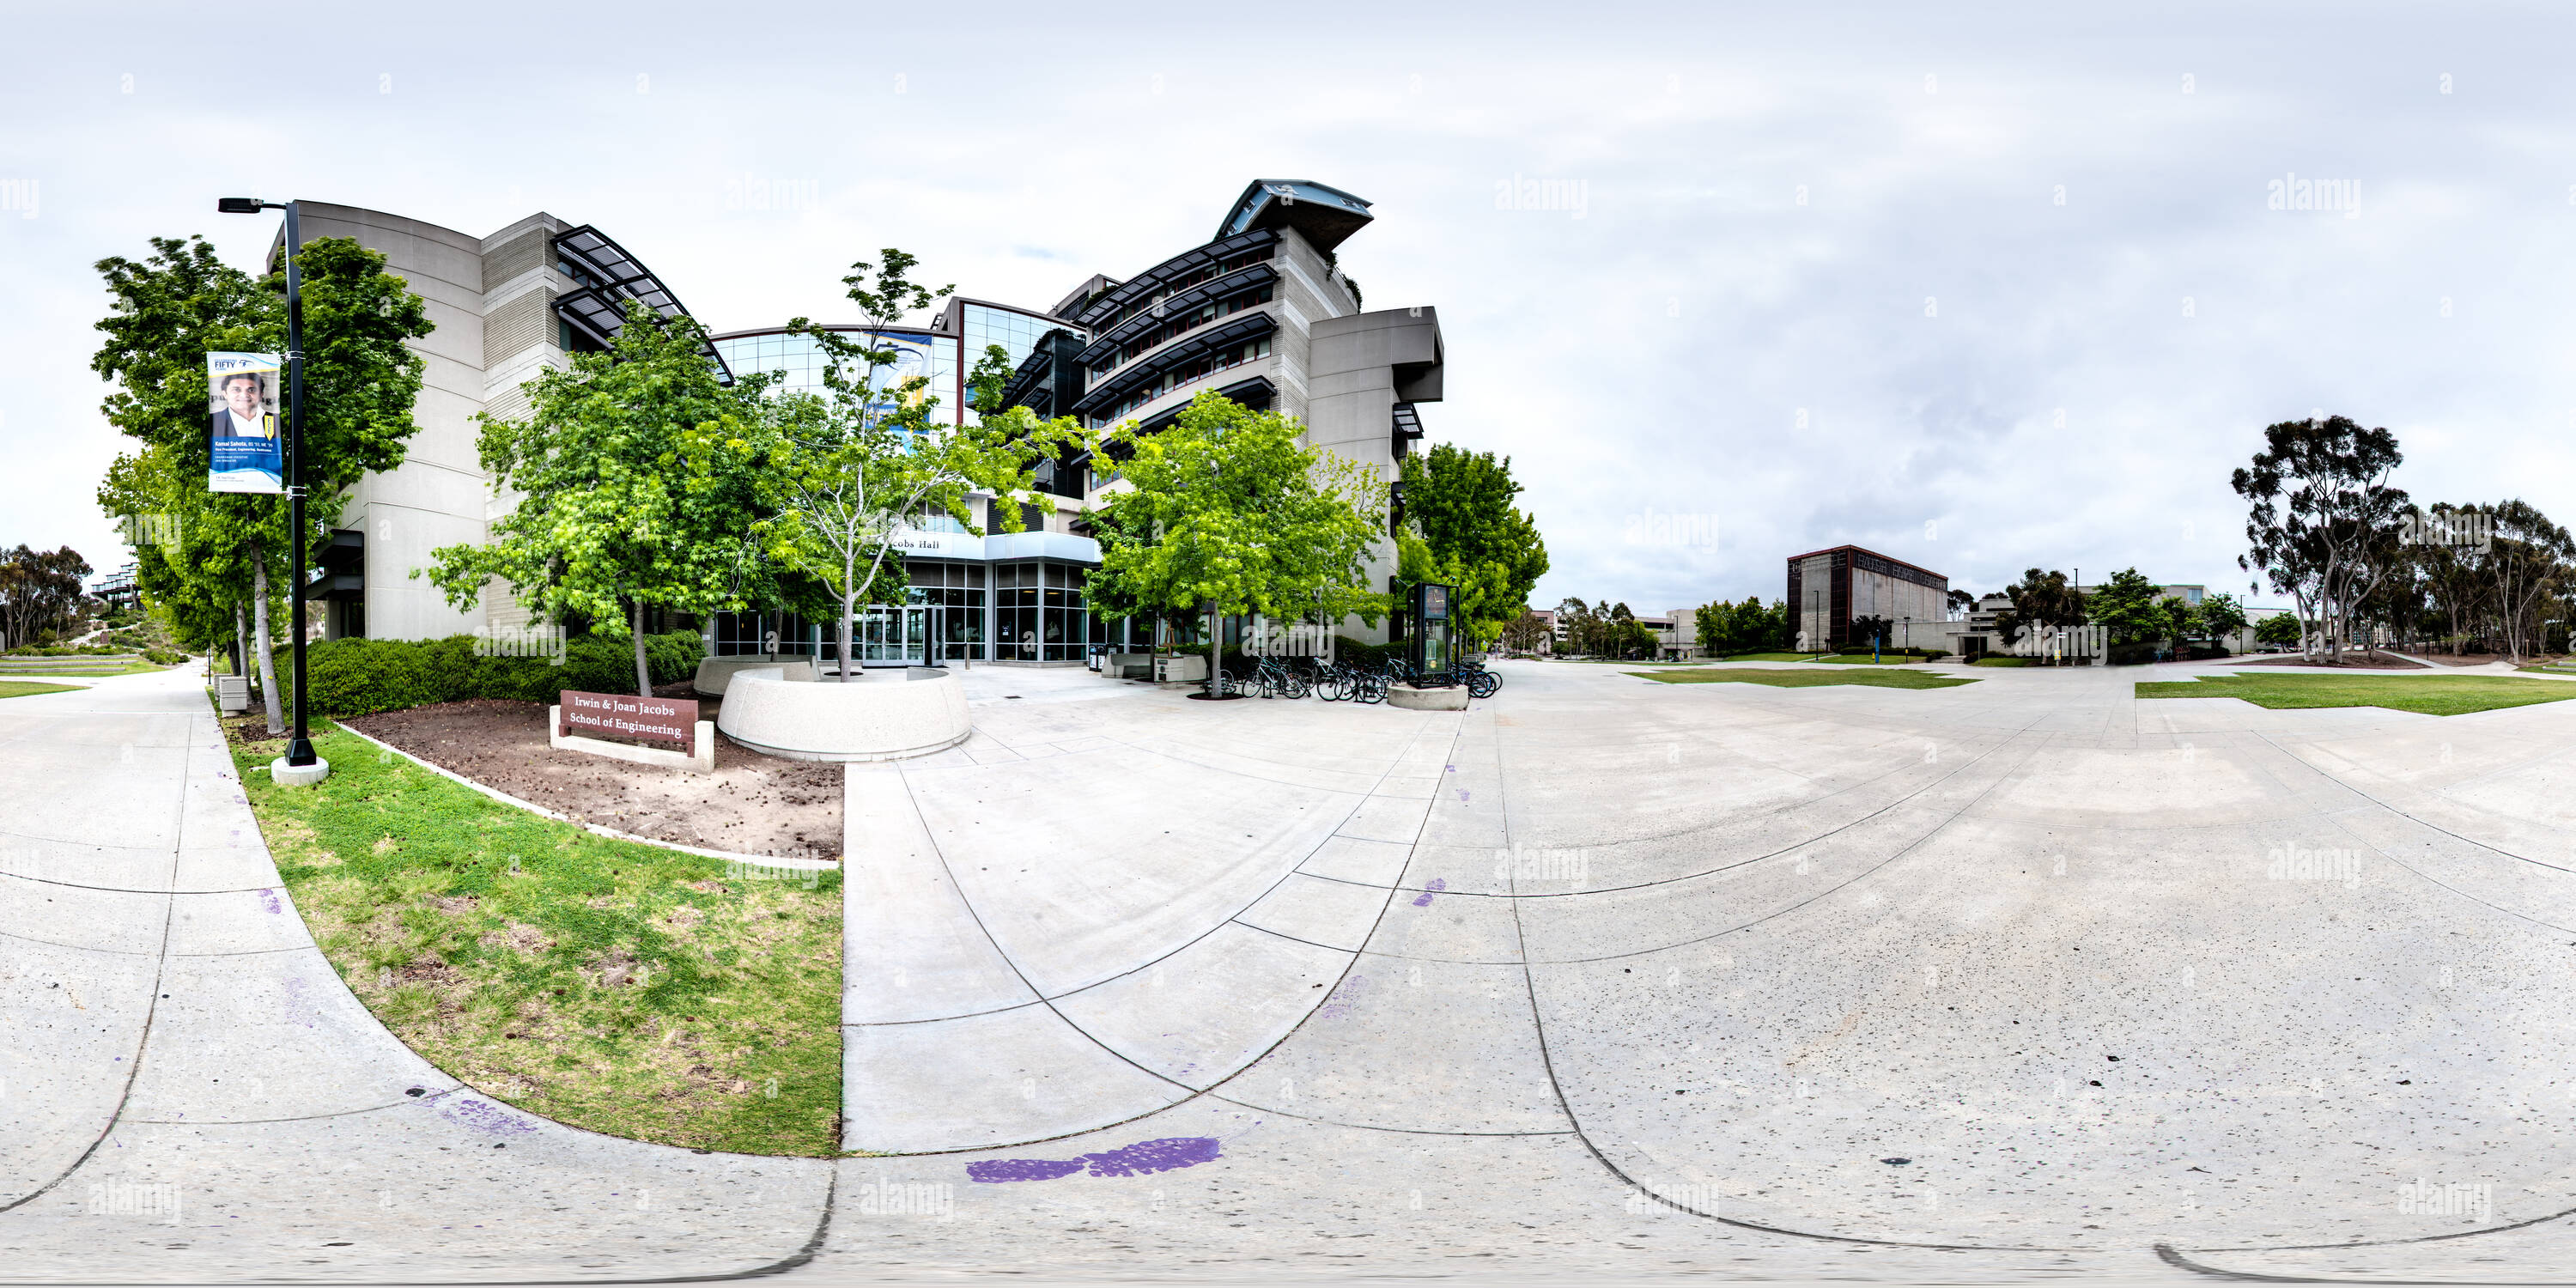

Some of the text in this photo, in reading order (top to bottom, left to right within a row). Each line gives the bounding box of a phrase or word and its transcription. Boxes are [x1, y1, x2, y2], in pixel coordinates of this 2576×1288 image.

[893, 539, 939, 549] cobs Hall
[574, 696, 675, 716] Irwin & Joan Jacobs
[570, 713, 682, 739] School of Engineering
